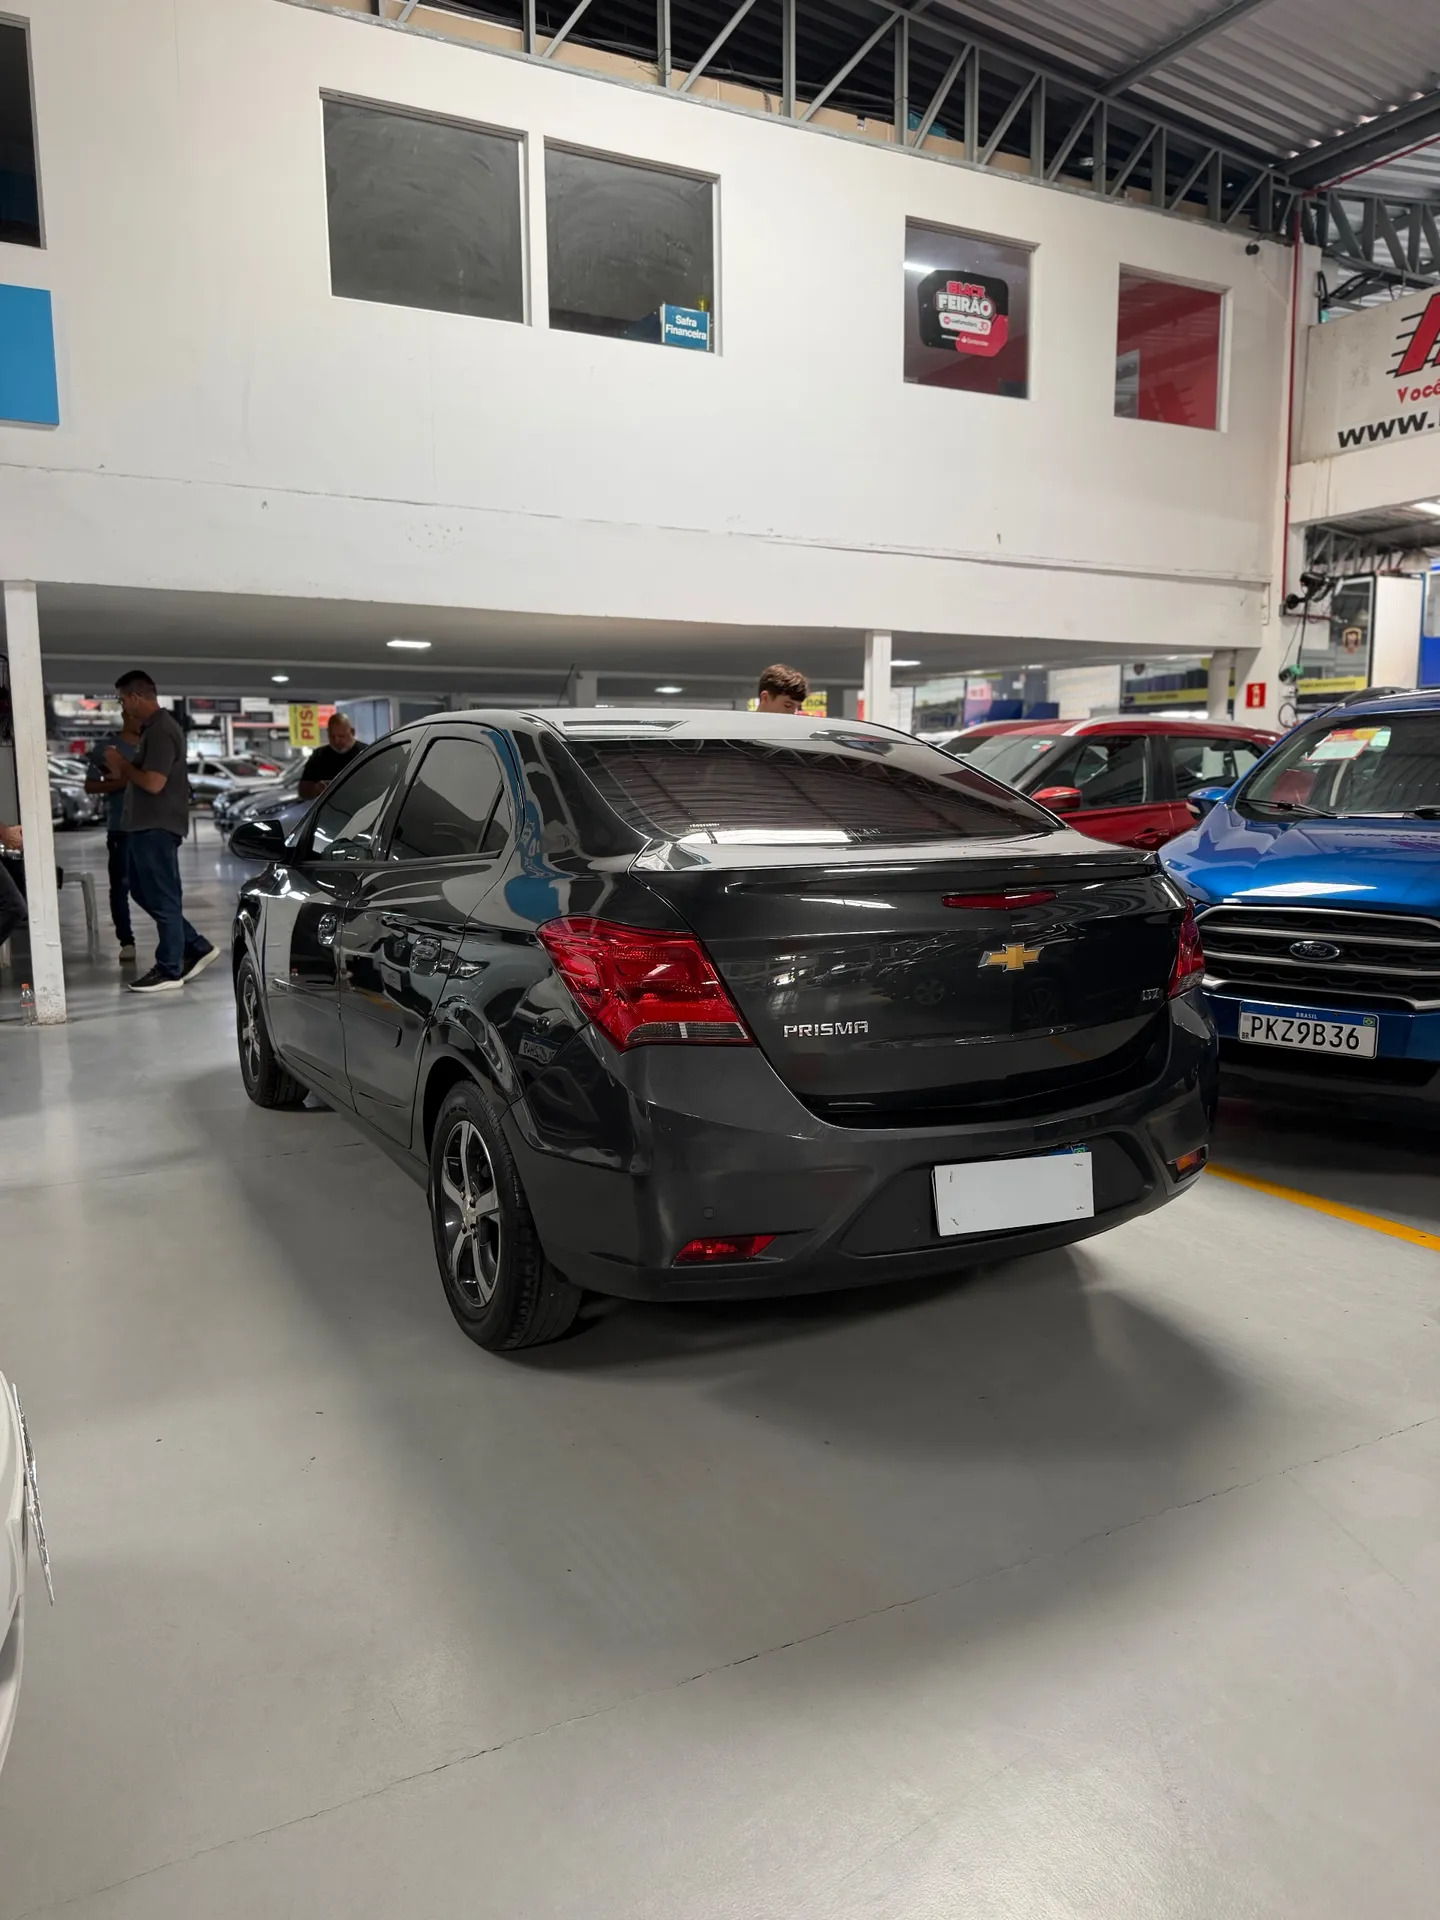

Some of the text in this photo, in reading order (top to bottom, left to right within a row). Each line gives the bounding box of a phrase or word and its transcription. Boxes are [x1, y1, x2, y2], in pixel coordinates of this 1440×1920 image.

[947, 281, 985, 298] BLACK
[938, 294, 992, 317] FEIRÃO
[675, 315, 697, 327] Safra
[665, 324, 707, 340] Financeira
[1337, 411, 1440, 448] www.
[299, 703, 315, 740] PIS
[1295, 1012, 1318, 1020] BRASIL
[783, 1020, 869, 1038] PRISMA
[1250, 1016, 1360, 1050] PKZ9B36
